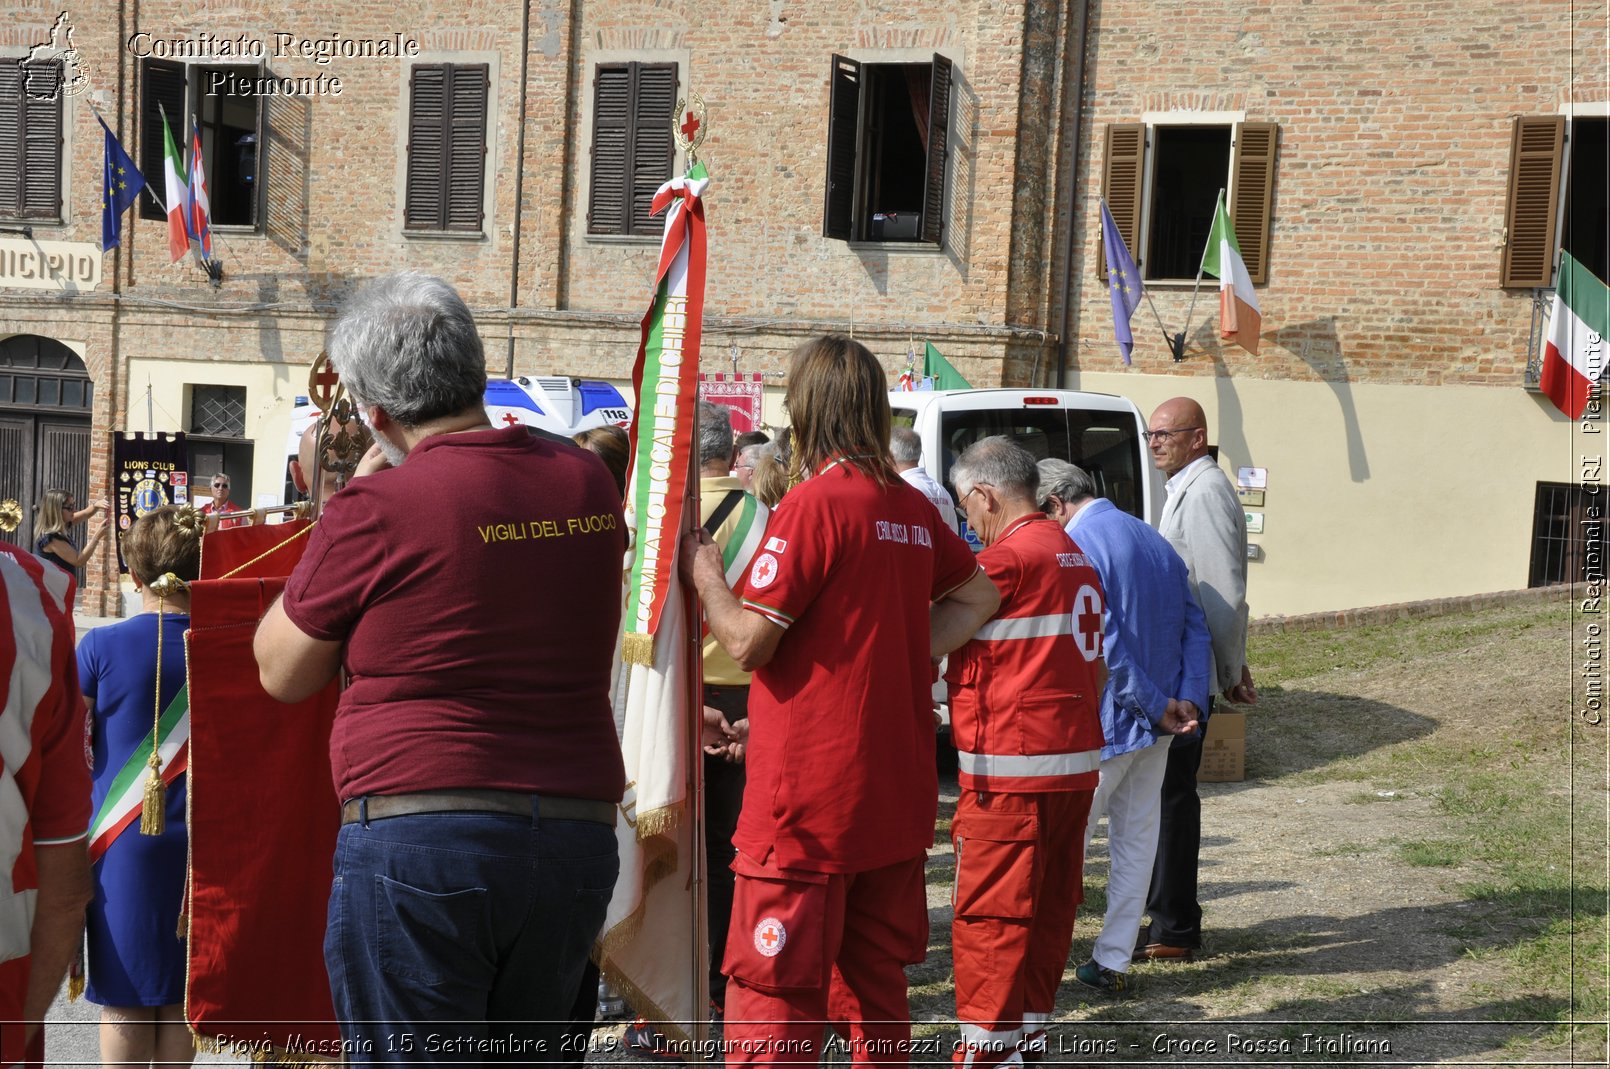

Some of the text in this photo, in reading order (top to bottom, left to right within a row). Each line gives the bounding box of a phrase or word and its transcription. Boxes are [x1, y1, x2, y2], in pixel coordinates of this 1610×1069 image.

[603, 409, 628, 420] 118
[124, 460, 175, 471] LIONS CLUB
[637, 295, 689, 622] COMITATO LOCALE DI CHIERI
[477, 513, 616, 543] VIGILI DEL FUOCO
